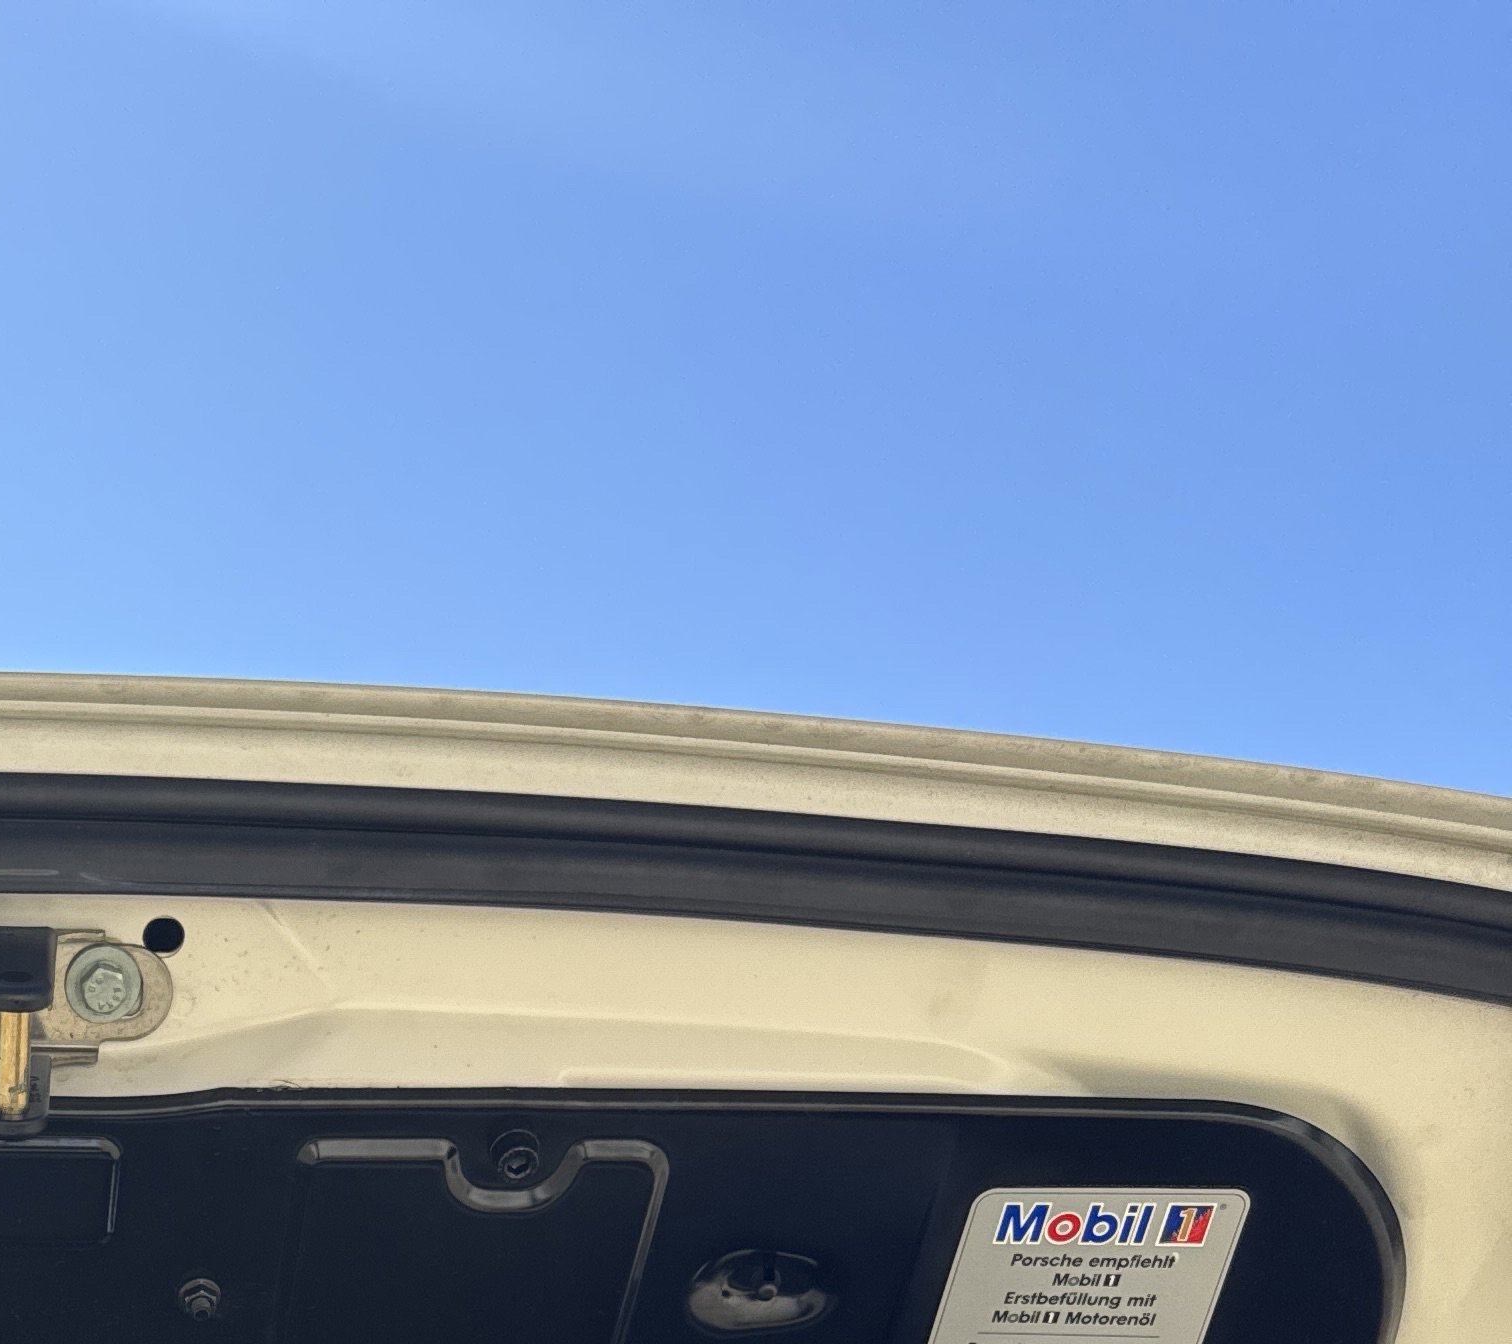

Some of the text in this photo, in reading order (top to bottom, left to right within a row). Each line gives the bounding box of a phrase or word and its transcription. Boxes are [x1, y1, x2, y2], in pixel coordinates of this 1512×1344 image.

[993, 1202, 1156, 1246] Mobil
[1010, 1253, 1176, 1272] Porsche empfiehlt
[1052, 1272, 1101, 1287] Mobil
[1003, 1291, 1157, 1309] Erstbefüllung mit
[991, 1310, 1040, 1324] Mobil
[1064, 1311, 1156, 1327] Motorenöl
